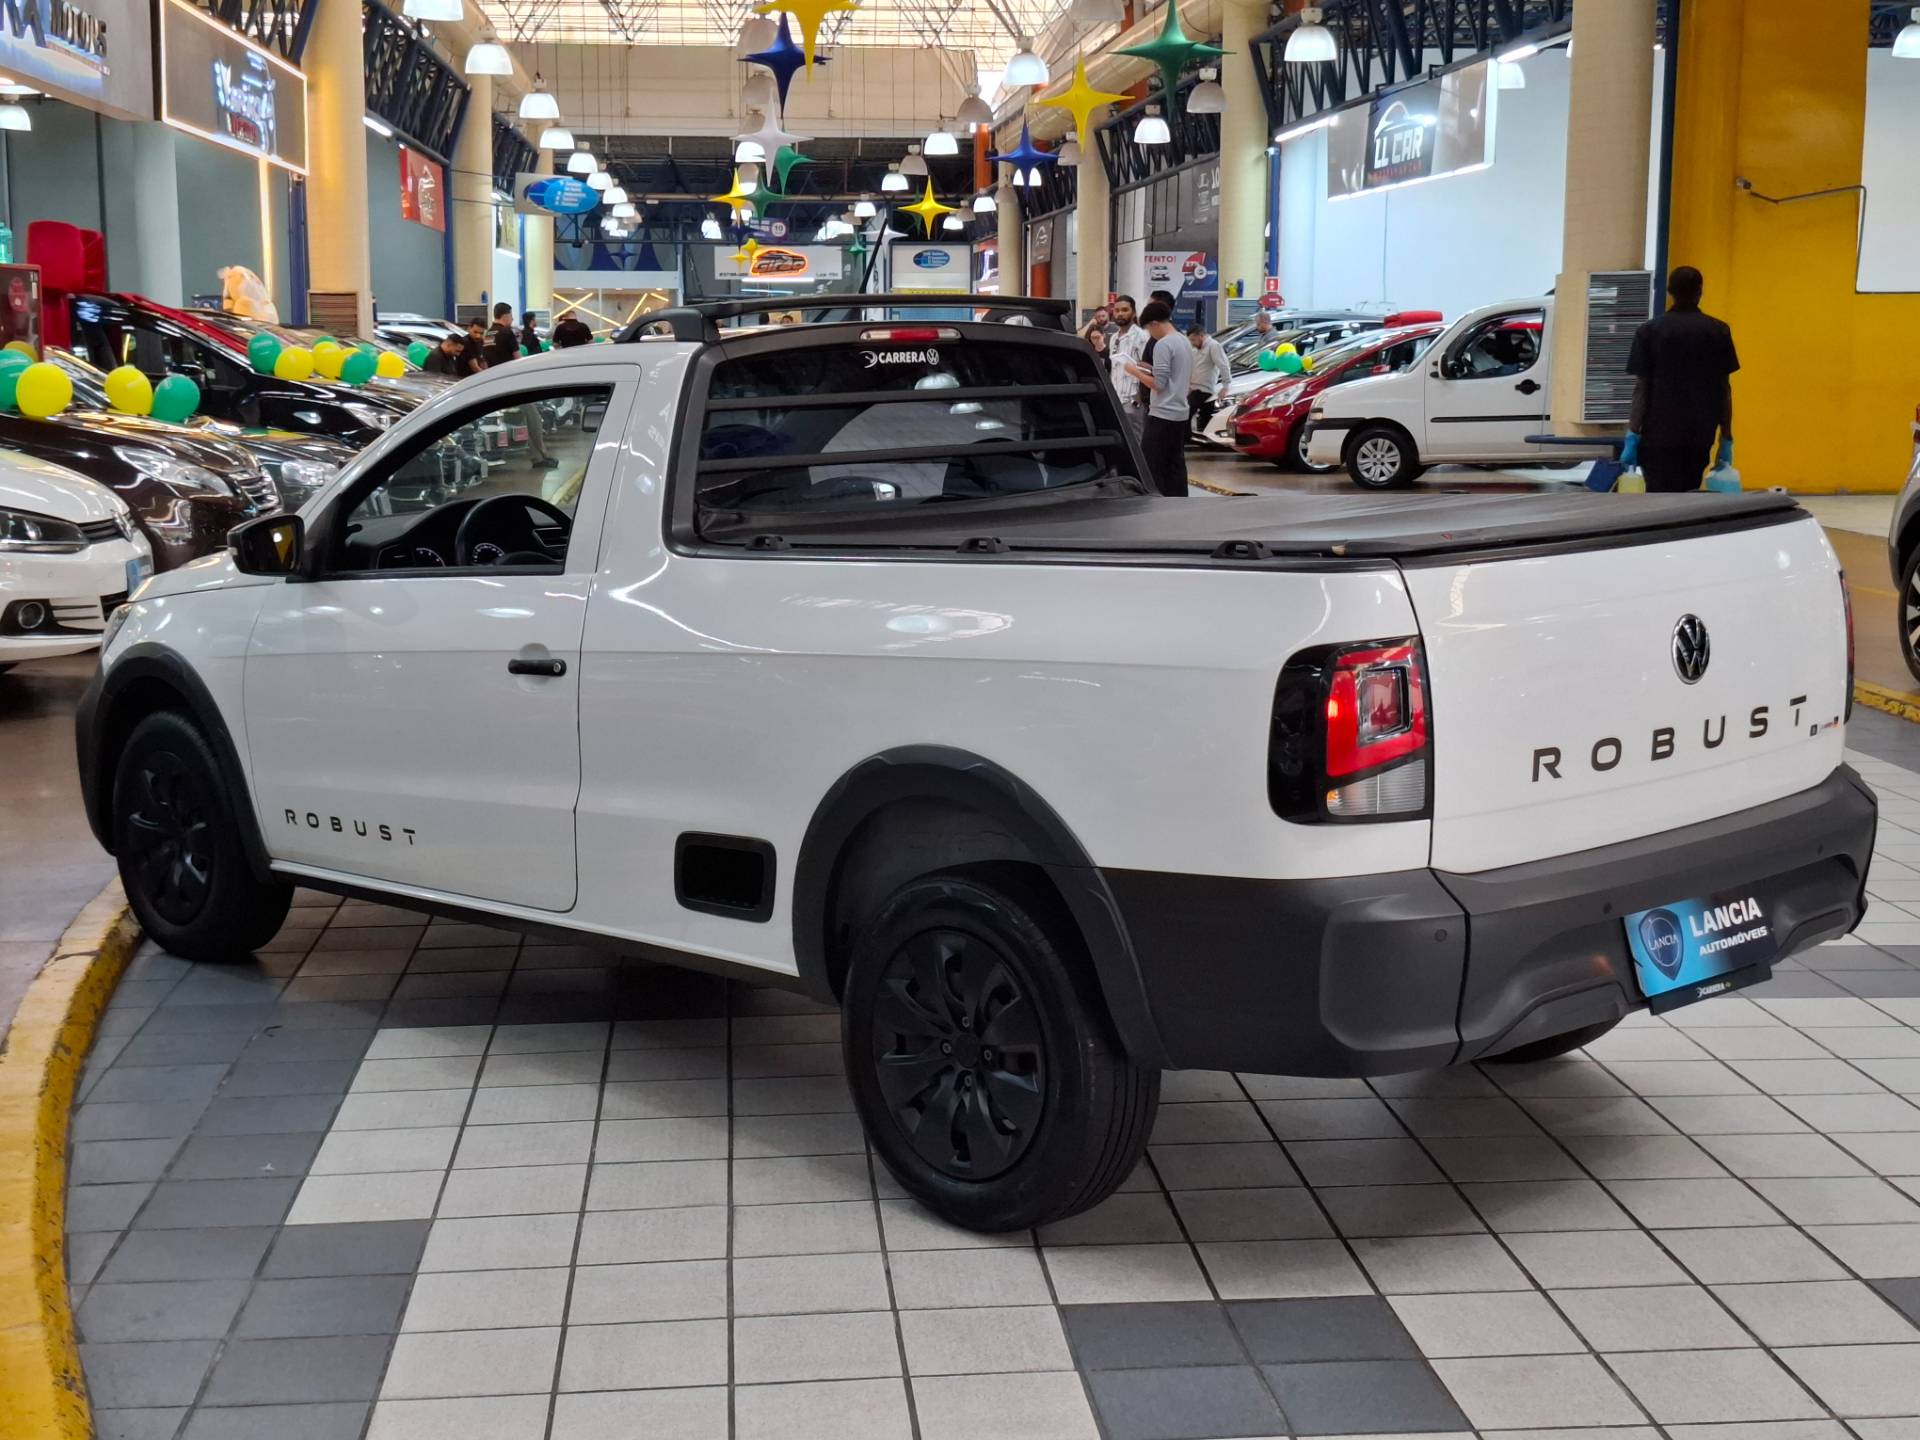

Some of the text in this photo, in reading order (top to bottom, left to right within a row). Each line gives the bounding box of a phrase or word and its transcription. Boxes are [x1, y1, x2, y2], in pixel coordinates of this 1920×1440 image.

[1392, 126, 1424, 165] CAR
[878, 351, 927, 364] CARRERA
[1531, 695, 1807, 783] ROBUST
[284, 808, 416, 846] ROBUST
[1689, 897, 1763, 938] LANCIA
[1647, 933, 1680, 951] LANCIA
[1699, 926, 1768, 956] AUTOMÓVEIS
